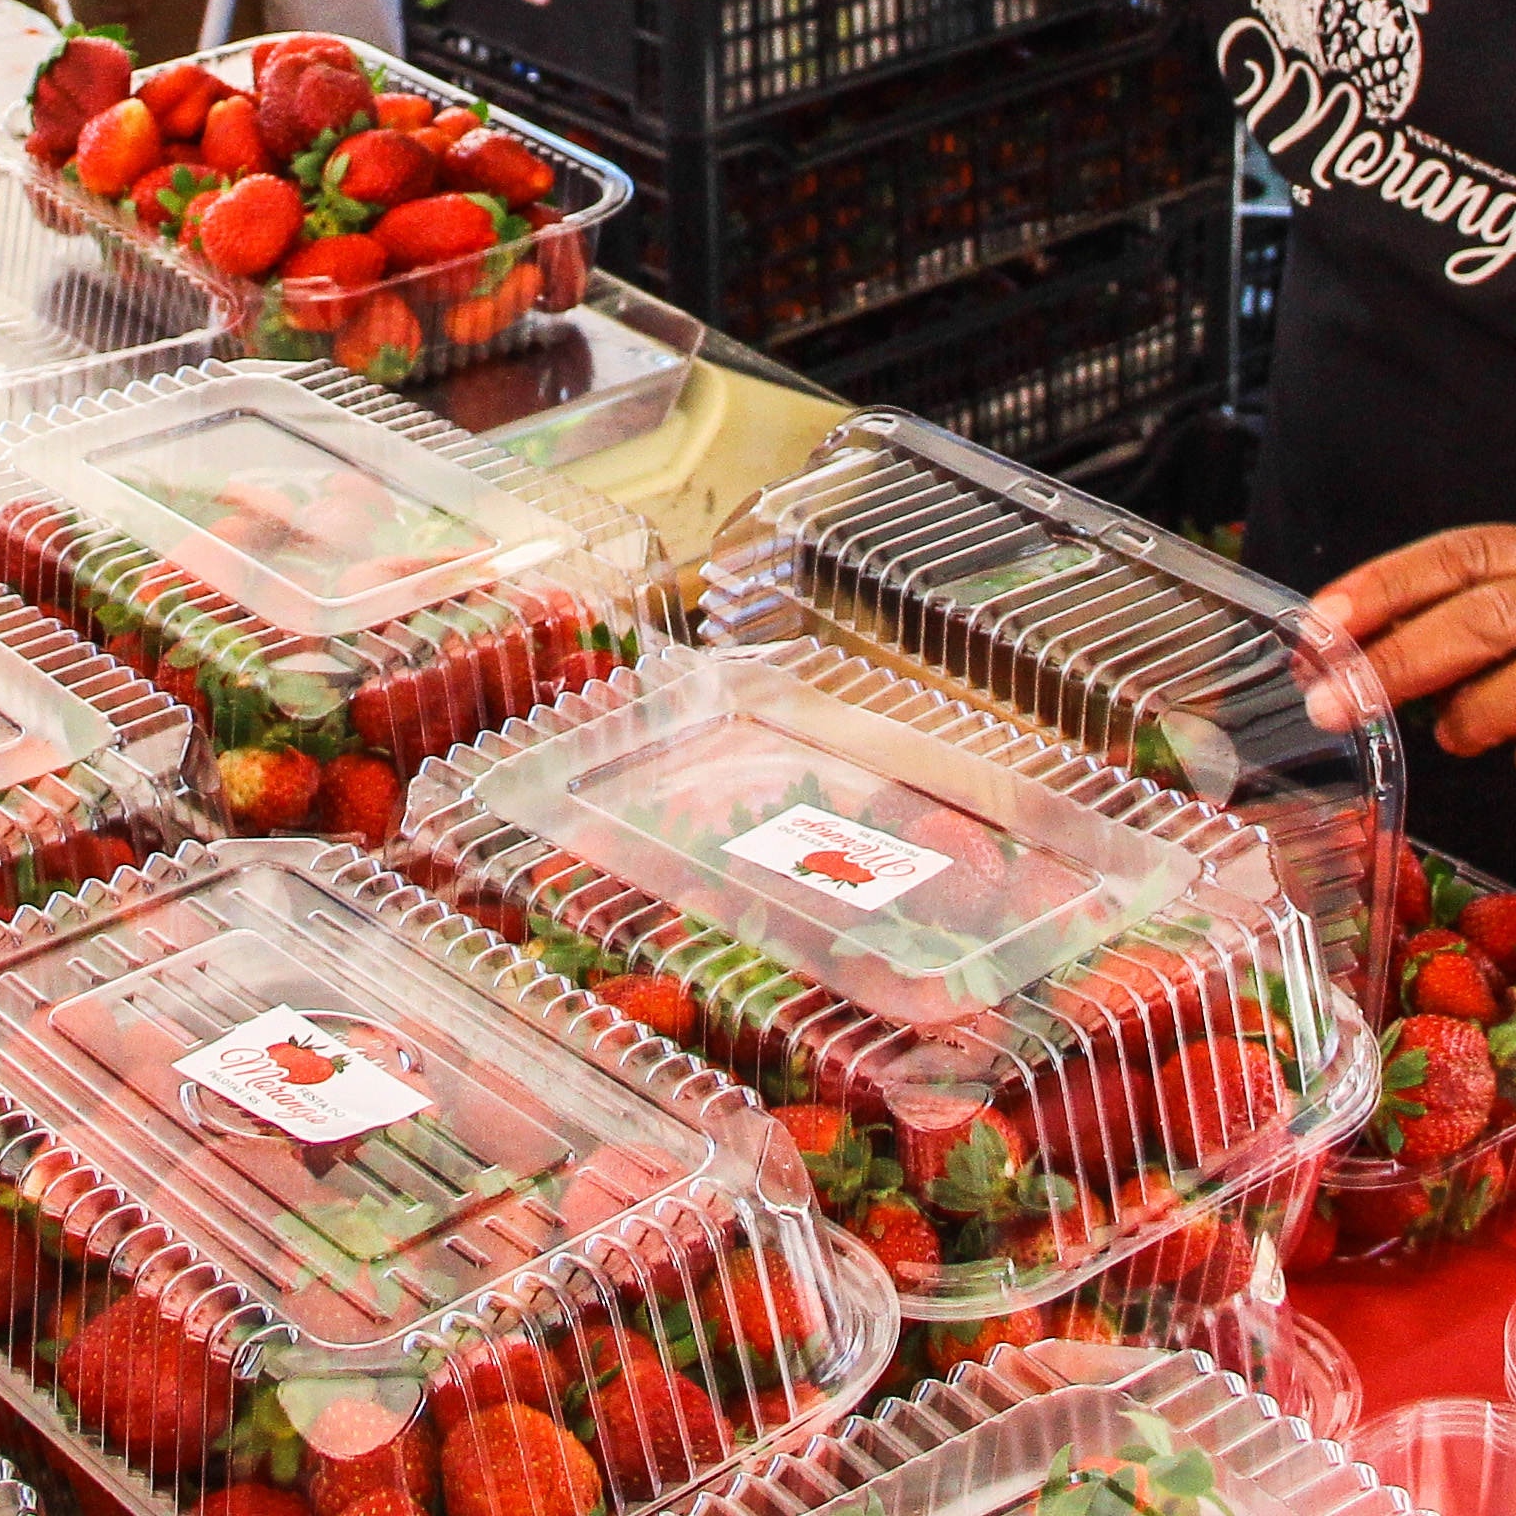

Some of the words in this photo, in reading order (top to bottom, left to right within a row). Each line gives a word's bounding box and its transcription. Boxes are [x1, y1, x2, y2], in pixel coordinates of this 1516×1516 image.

[777, 825, 796, 835] DO
[797, 832, 833, 849] FESTA
[791, 817, 916, 877] Morango
[206, 1069, 244, 1094] PELOTAS
[247, 1095, 261, 1105] RS
[220, 1047, 328, 1124] Morango
[295, 1087, 328, 1109] FESTA
